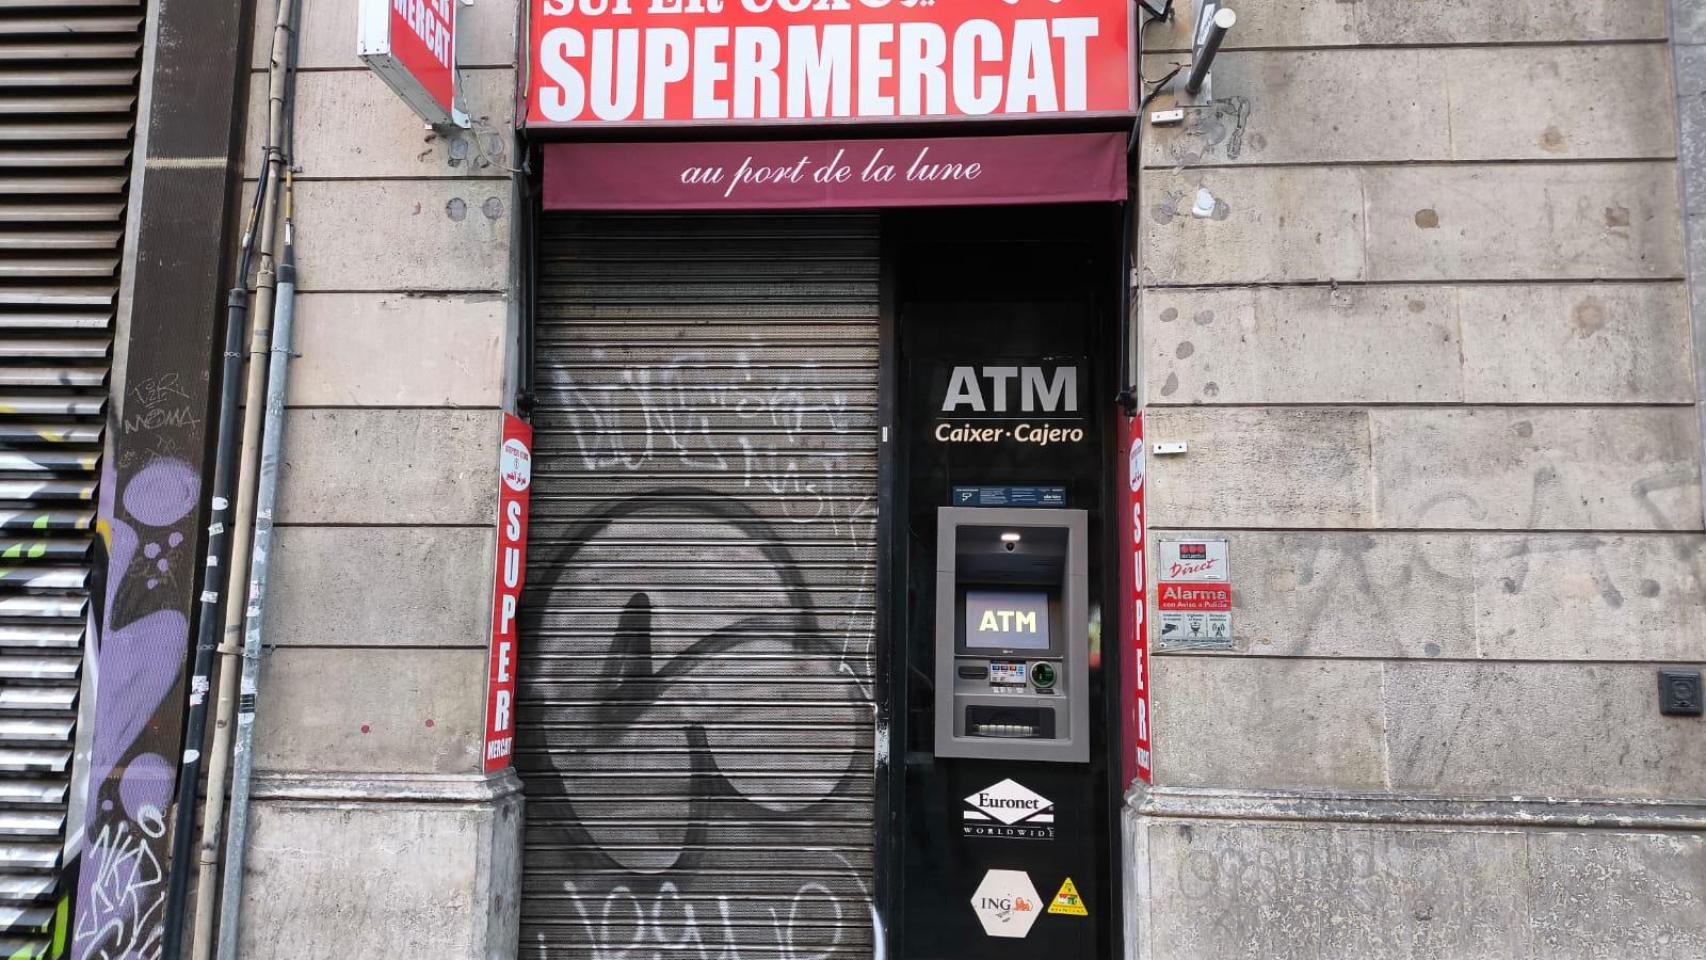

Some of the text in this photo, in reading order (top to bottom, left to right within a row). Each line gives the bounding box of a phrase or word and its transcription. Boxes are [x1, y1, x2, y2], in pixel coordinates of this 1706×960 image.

[539, 17, 1099, 122] SUPERMERCAT
[680, 146, 982, 198] au port de la lune
[941, 366, 1078, 412] ATM
[1170, 558, 1220, 578] Direct
[1163, 586, 1227, 600] Alarma
[495, 500, 522, 732] SUPER
[979, 609, 1037, 633] ATM
[1133, 502, 1147, 741] SUPER
[978, 793, 1040, 810] Euronet
[981, 897, 1011, 911] ING
